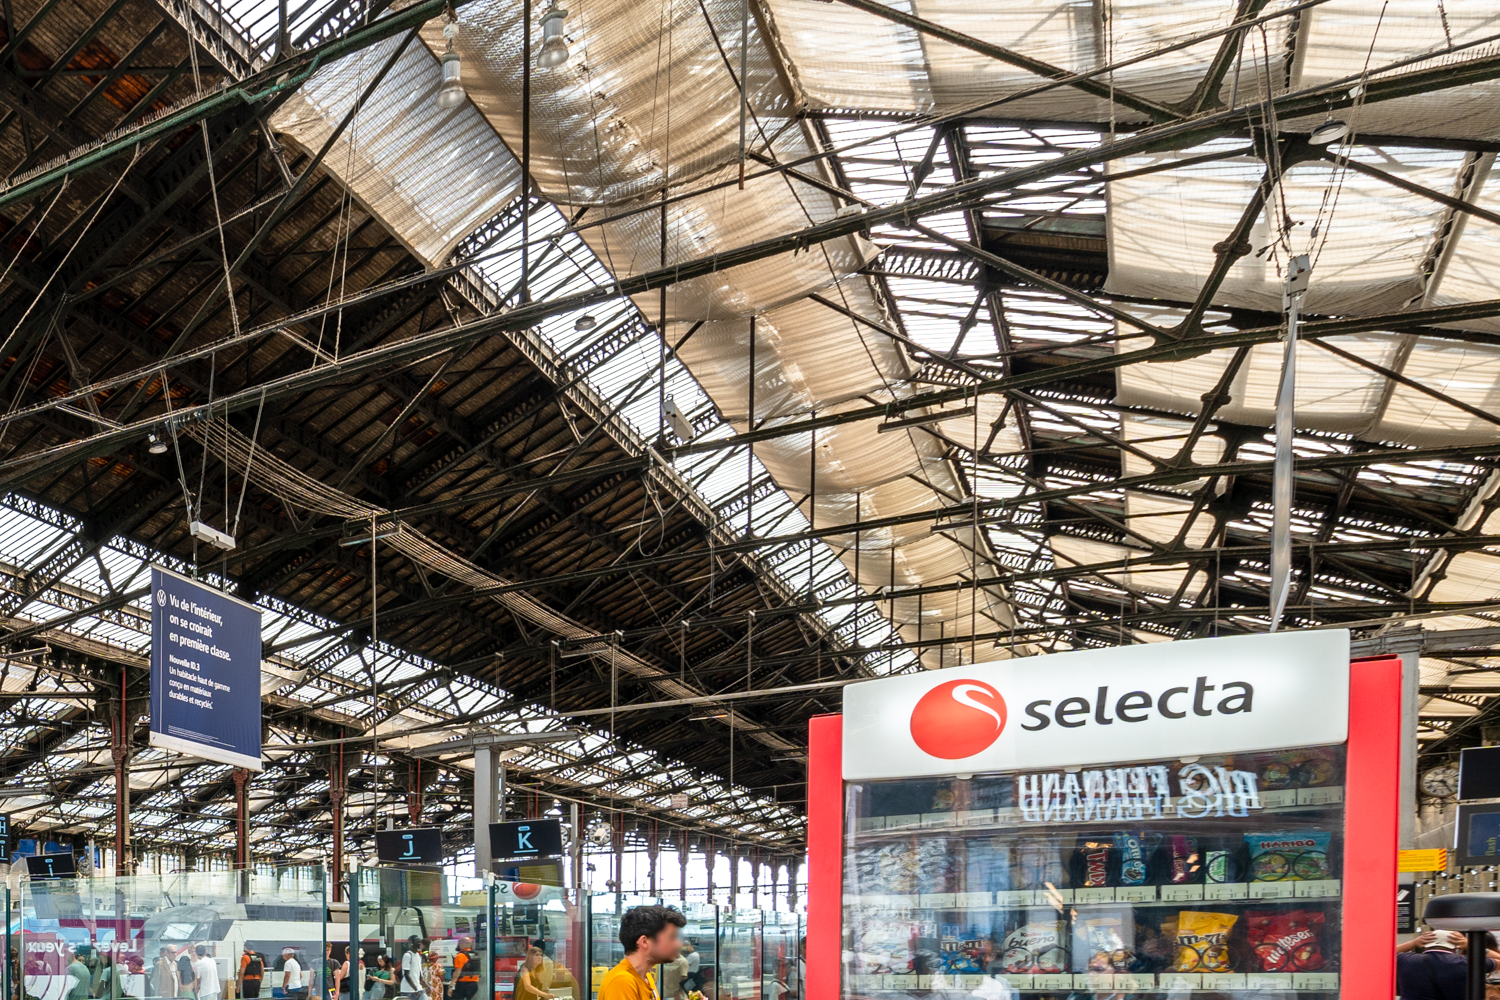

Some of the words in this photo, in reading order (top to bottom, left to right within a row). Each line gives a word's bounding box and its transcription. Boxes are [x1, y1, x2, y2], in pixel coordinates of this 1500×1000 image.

[169, 593, 180, 609] Vu
[180, 599, 190, 612] de
[190, 601, 223, 627] l'intérieur,
[169, 614, 179, 626] on
[180, 619, 188, 629] se
[189, 622, 213, 638] croirait
[169, 632, 179, 643] en
[179, 636, 209, 654] première
[210, 645, 232, 662] classe.
[169, 653, 190, 668] Nouvelle
[190, 661, 200, 672] ID.3
[169, 666, 177, 675] Un
[177, 668, 197, 682] habitacle
[197, 675, 208, 685] haut
[208, 679, 214, 687] de
[214, 681, 231, 693] gamme
[169, 679, 183, 690] conçu
[184, 683, 190, 691] en
[190, 685, 212, 698] matériaux
[169, 690, 188, 703] durables
[189, 696, 194, 704] et
[1020, 675, 1255, 732] selecta
[403, 840, 414, 856] J
[518, 832, 534, 849] K
[1261, 838, 1316, 850] HARIBO
[1127, 838, 1142, 870] OREO
[1086, 849, 1108, 887] TWIX
[1008, 935, 1056, 947] bueno
